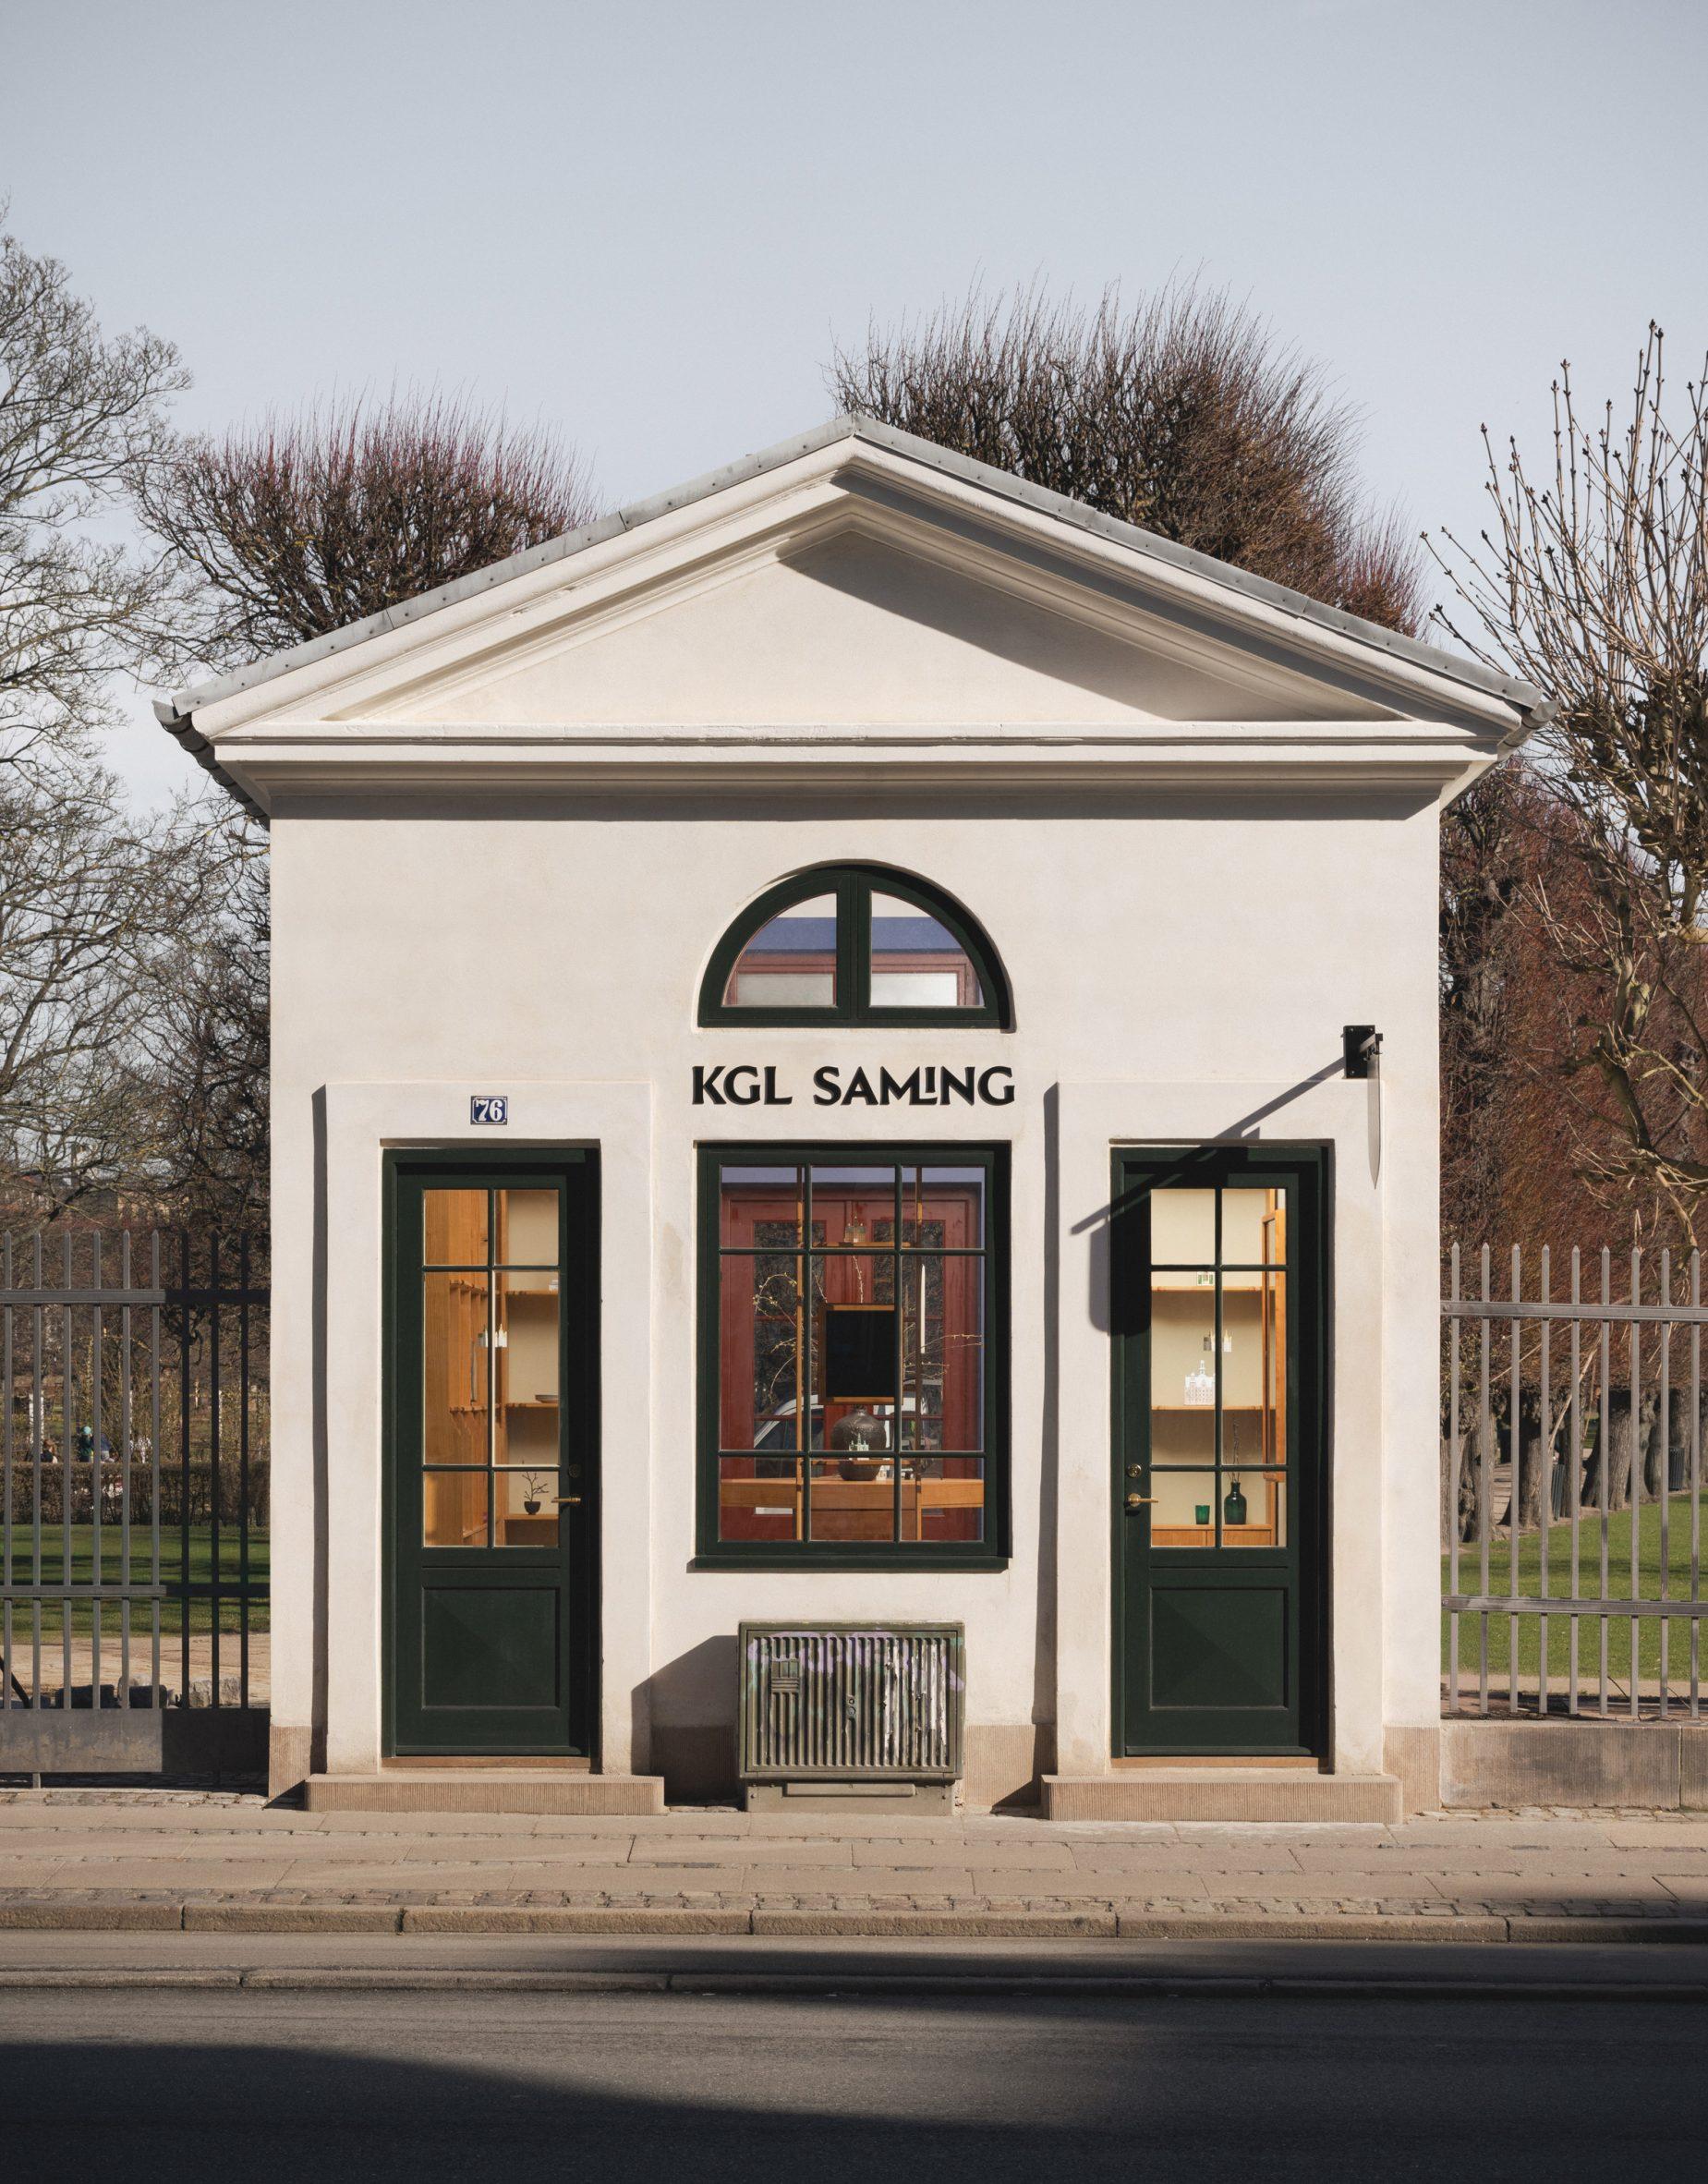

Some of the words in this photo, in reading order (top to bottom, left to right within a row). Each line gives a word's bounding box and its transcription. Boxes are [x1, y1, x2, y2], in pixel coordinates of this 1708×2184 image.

[692, 1065, 793, 1106] KGL
[813, 1065, 1015, 1107] SAMLING
[475, 1099, 503, 1122] 76
